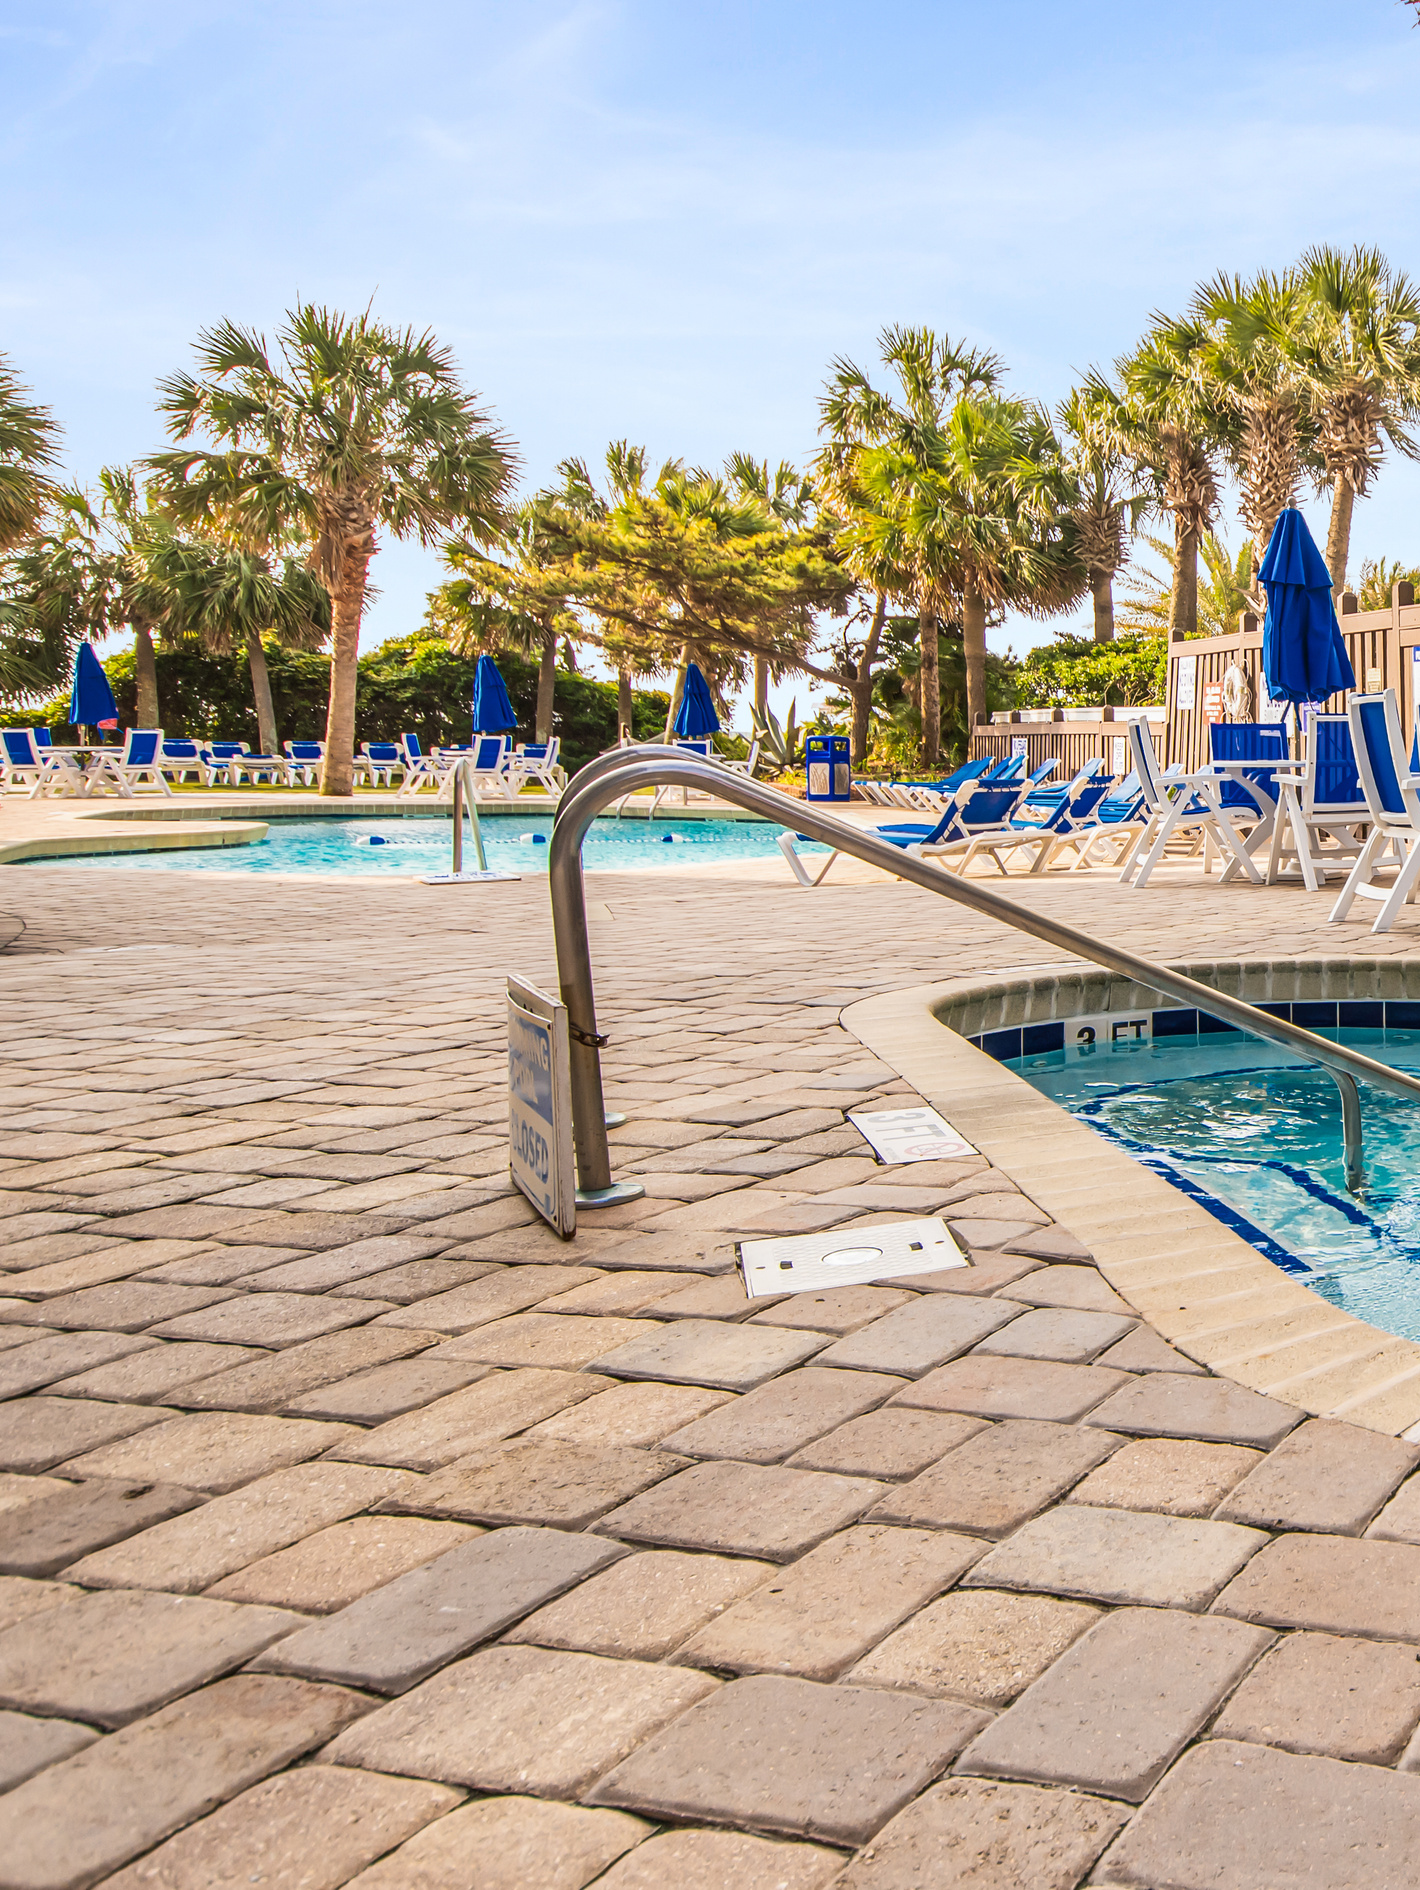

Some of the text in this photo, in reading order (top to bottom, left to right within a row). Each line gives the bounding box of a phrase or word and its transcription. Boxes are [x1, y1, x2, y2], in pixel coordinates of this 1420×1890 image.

[1076, 1019, 1148, 1046] 3 FT
[867, 1112, 947, 1142] 3 FT
[511, 1107, 549, 1185] CLOSED
